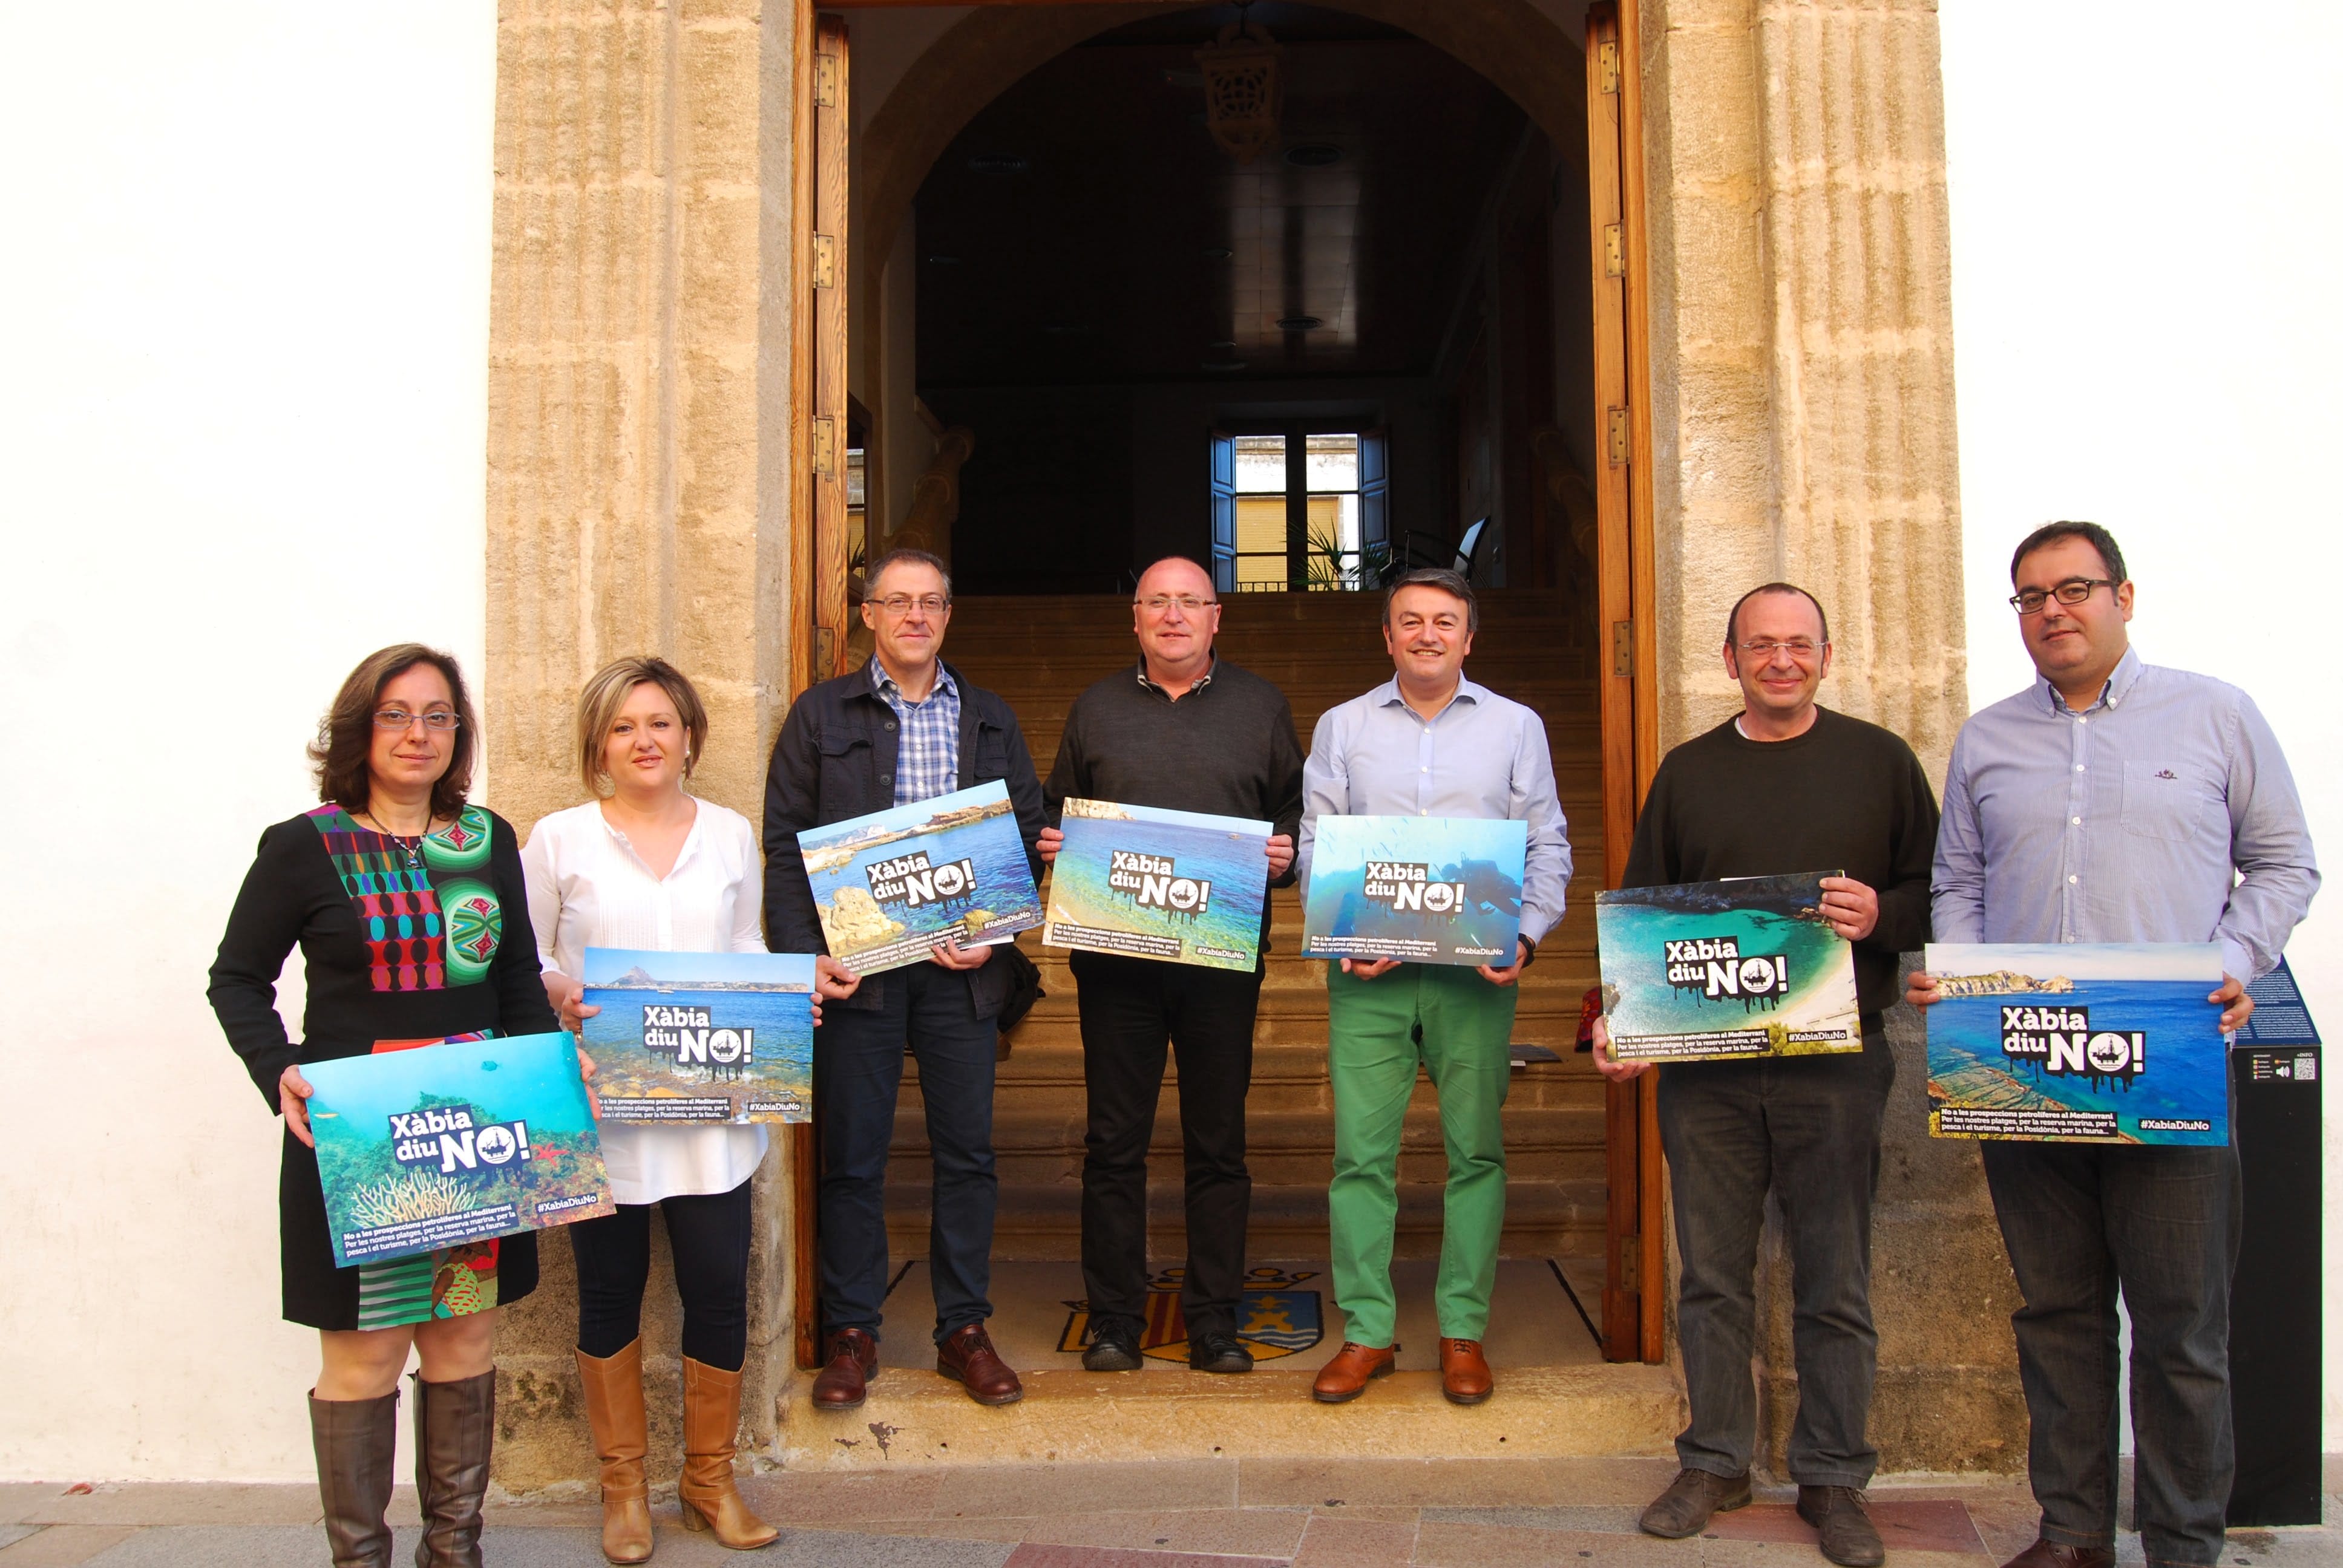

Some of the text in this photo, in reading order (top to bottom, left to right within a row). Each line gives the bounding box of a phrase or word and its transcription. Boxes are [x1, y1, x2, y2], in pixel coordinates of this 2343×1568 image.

[867, 851, 929, 884] Xàbia
[1112, 851, 1174, 875] Xàbia
[1366, 863, 1427, 881] Xàbia
[873, 858, 977, 907] diu NO!
[1109, 871, 1210, 912] diu NO!
[1364, 881, 1466, 912] diu NO!
[983, 909, 1031, 930] #XabiaDiuNo
[1197, 947, 1245, 959] #XabiaDiuNo
[1666, 936, 1738, 962] Xàbia
[1668, 956, 1788, 998] diu NO!
[644, 1007, 710, 1027] Xàbia
[2003, 1007, 2087, 1030] Xàbia
[645, 1029, 752, 1063] diu NO!
[1788, 1030, 1845, 1042] #XabiaDiuNo
[2004, 1033, 2143, 1072] diu NO!
[749, 1102, 799, 1112] #XabiaDiuNo
[1970, 1109, 2017, 1118] prospeccions
[391, 1104, 473, 1140] Xàbia
[2140, 1120, 2209, 1129] #XabiaDiuNo
[396, 1120, 531, 1174] diu NO!
[536, 1193, 596, 1214] #XabiaDiuNo
[343, 1232, 355, 1241] No
[361, 1229, 372, 1237] les
[373, 1220, 421, 1236] prospeccions
[470, 1203, 511, 1217] Mediterrani
[344, 1240, 357, 1248] Per
[369, 1233, 395, 1244] nostres
[423, 1227, 436, 1235] per
[444, 1220, 469, 1230] reserva
[496, 1213, 508, 1221] per
[346, 1247, 367, 1257] pesca
[409, 1237, 421, 1246] per
[465, 1227, 478, 1235] per
